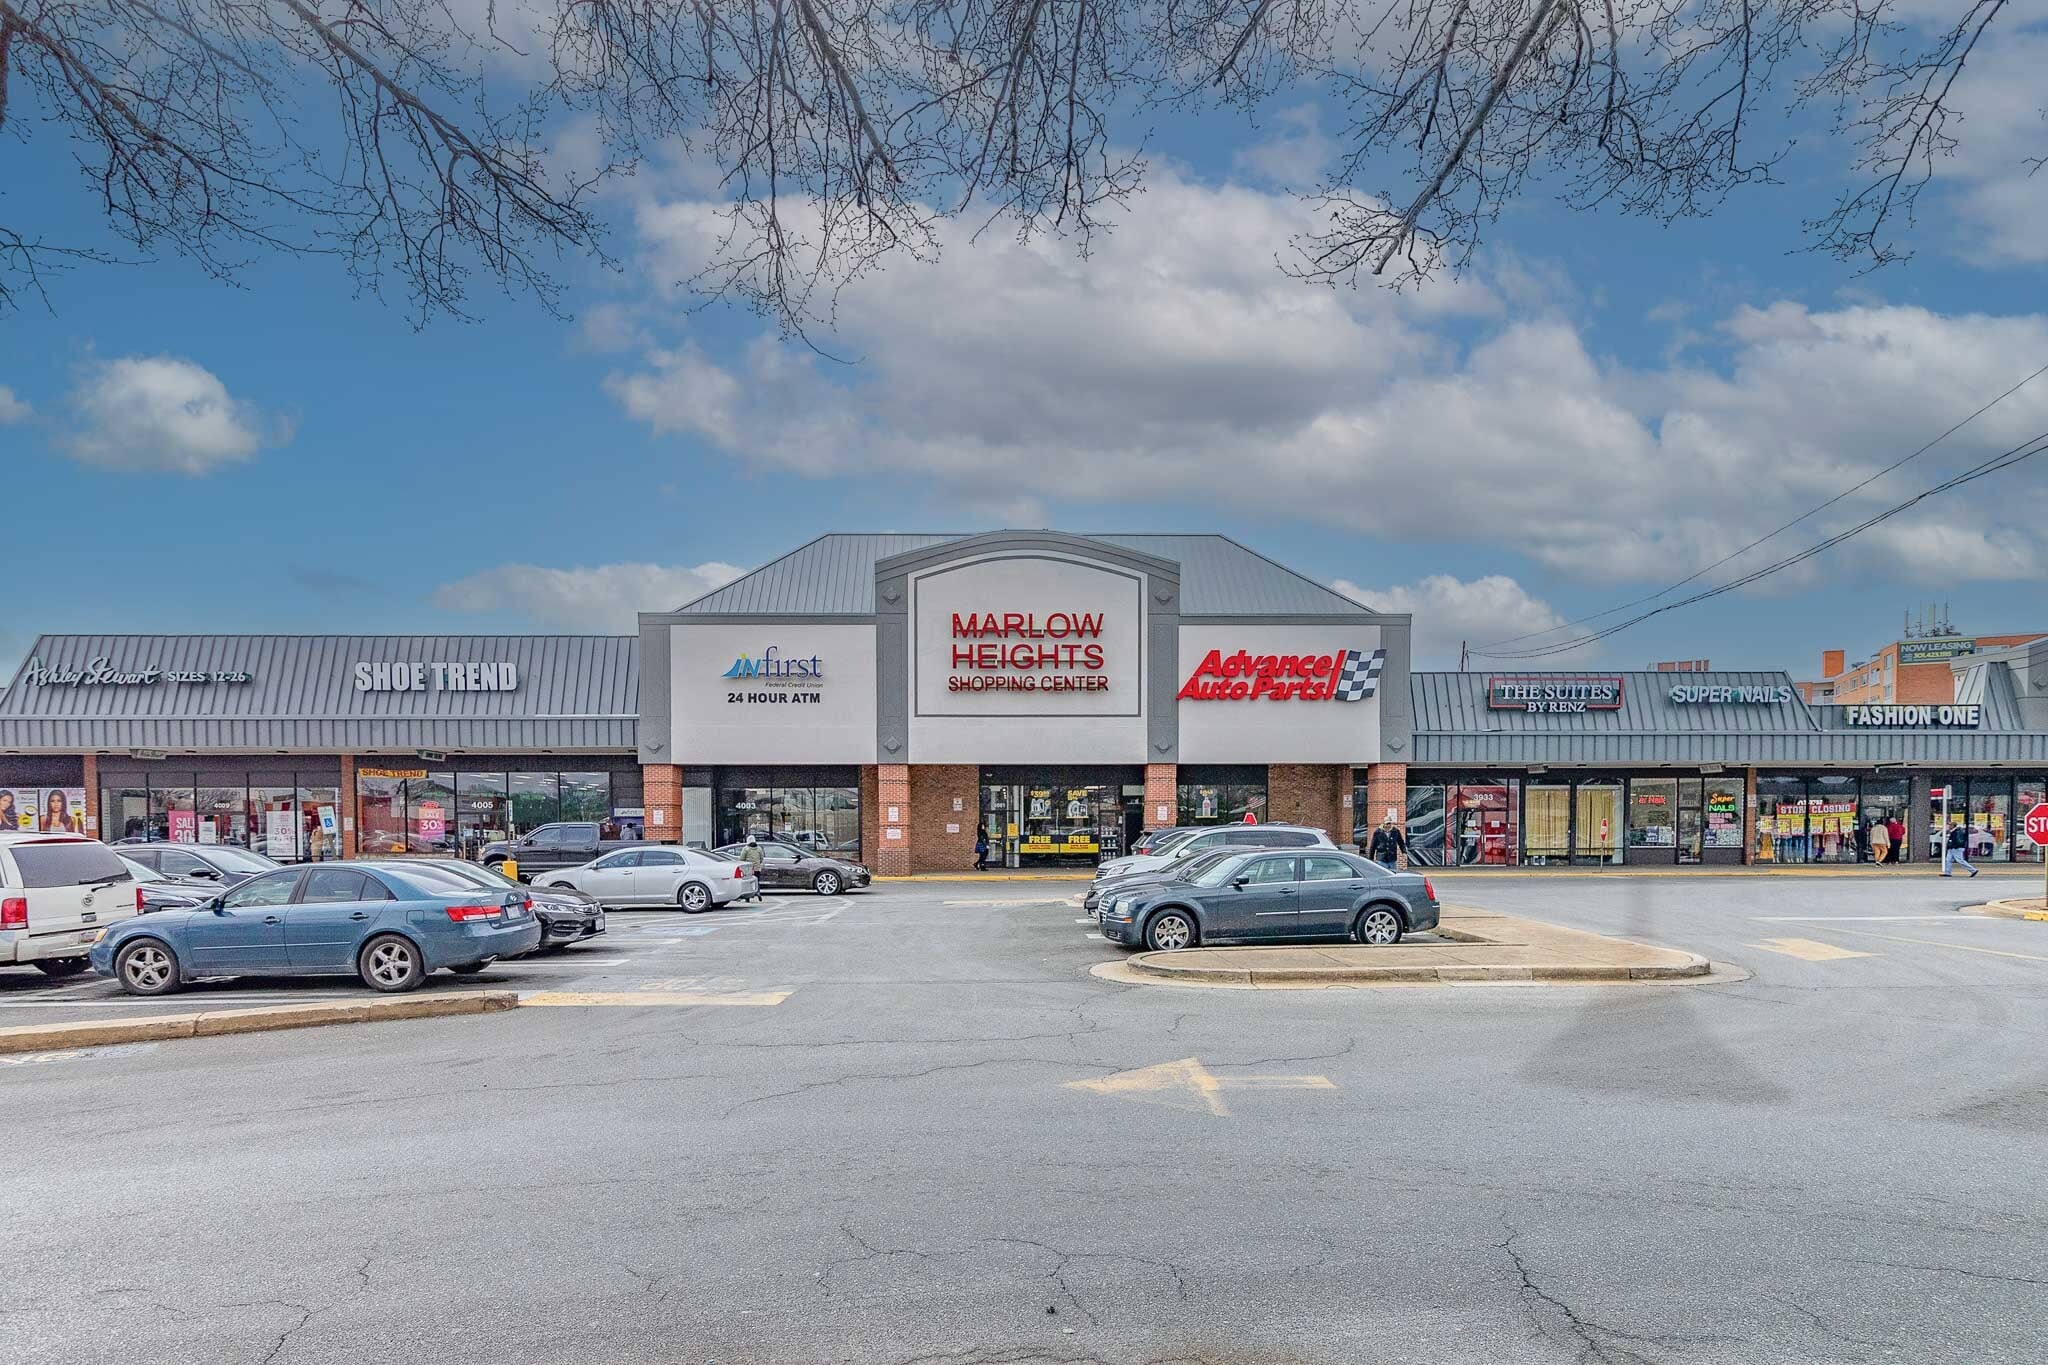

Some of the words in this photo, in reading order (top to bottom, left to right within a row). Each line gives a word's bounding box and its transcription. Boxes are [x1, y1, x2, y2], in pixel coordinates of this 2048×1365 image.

[952, 613, 1104, 639] MARLOW
[1901, 643, 1928, 653] NOW
[1928, 641, 1972, 651] LEASING
[952, 643, 1105, 670] HEIGHTS
[1193, 650, 1333, 678] Advance
[24, 656, 84, 687] Ashley
[84, 656, 163, 685] Stewart
[167, 671, 206, 682] SIZES
[212, 671, 246, 682] 12-26
[354, 662, 426, 691] SHOE
[430, 662, 517, 691] TREND
[948, 676, 1036, 692] SHOPPING
[1040, 676, 1109, 692] CENTER
[1176, 676, 1249, 700] Auto
[1250, 676, 1326, 700] Parts
[727, 692, 744, 703] 24
[747, 692, 788, 703] HOUR
[791, 692, 821, 703] ATM
[1501, 684, 1540, 700] THE
[1544, 684, 1612, 700] SUITES
[1672, 684, 1732, 703] SUPER
[1738, 685, 1792, 703] NAILS
[1527, 701, 1547, 713] BY
[1549, 701, 1586, 713] RENZ
[1848, 705, 1931, 726] FASHION
[1938, 705, 1979, 726] ONE
[362, 769, 389, 777] SHOE
[392, 770, 424, 778] TREND
[471, 801, 494, 809] 4005
[1710, 792, 1735, 804] Super
[735, 802, 757, 810] 4003
[1708, 804, 1735, 812] NAILS
[1811, 804, 1851, 814] CLOSING
[2028, 816, 2048, 833] ST
[1028, 835, 1051, 844] FREE
[1068, 835, 1090, 844] FREE
